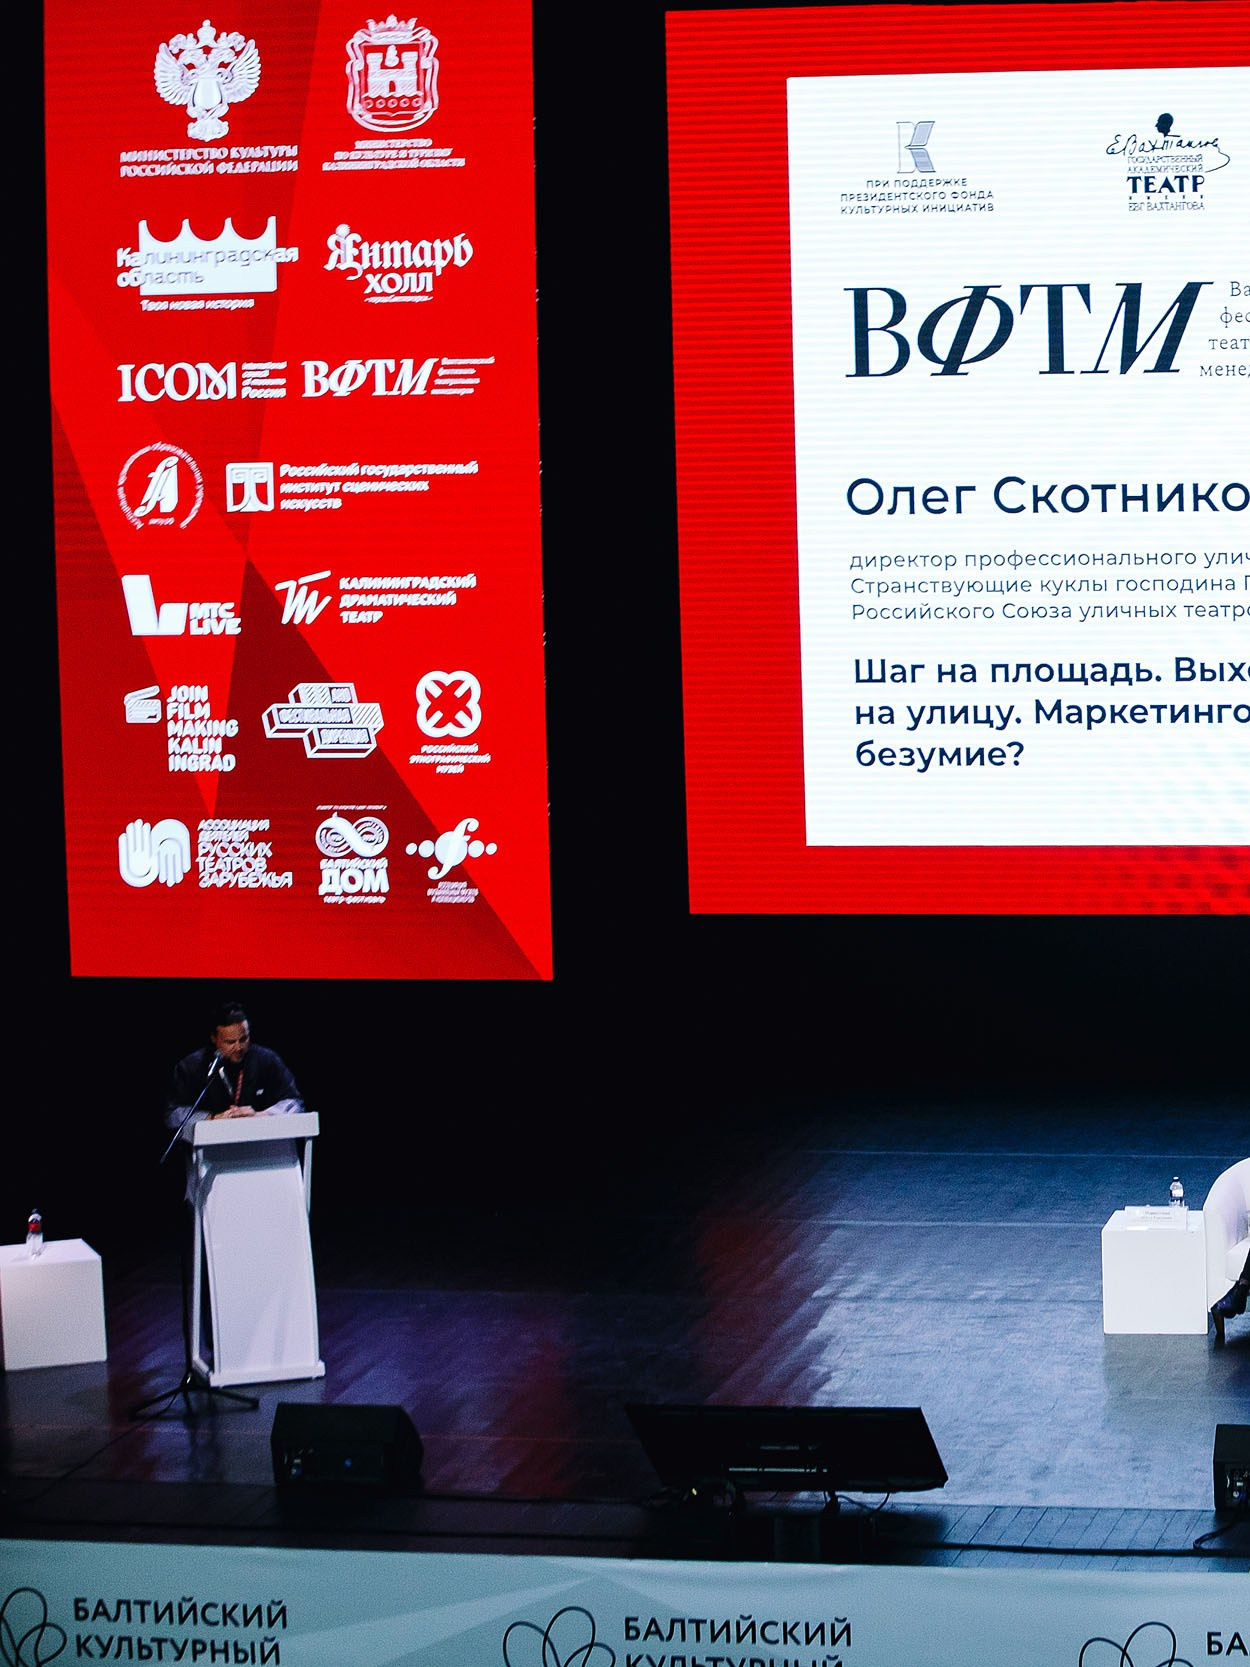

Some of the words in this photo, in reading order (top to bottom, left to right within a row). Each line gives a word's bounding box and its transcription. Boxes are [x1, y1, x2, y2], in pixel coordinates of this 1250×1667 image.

[120, 147, 228, 163] МИНИСТЕРСТВО
[230, 145, 298, 159] КУЛЬТУРЫ
[120, 160, 214, 177] РОССИЙСКОЙ
[216, 160, 298, 174] ФЕДЕРАЦИИ
[866, 179, 890, 189] ПРИ
[894, 177, 968, 189] ПОДДЕРЖКЕ
[1126, 175, 1205, 194] ТЕАТР
[841, 192, 946, 202] ПРЕЗИДЕНТСКОГО
[950, 190, 994, 200] ФОНДА
[841, 204, 918, 215] КУЛЬТУРНЫХ
[922, 203, 994, 213] ИНИЦИАТИВ
[117, 247, 299, 268] Калининградская
[323, 224, 474, 280] Янтарь
[117, 268, 205, 288] область
[843, 281, 1215, 378] ВФТМ
[117, 361, 237, 402] ICOM
[300, 357, 440, 398] ВФТМ
[280, 462, 359, 477] Российский
[360, 460, 479, 478] государственный
[280, 482, 342, 496] институт
[342, 481, 430, 494] сценических
[846, 477, 977, 517] Олег
[280, 497, 343, 512] искусств
[849, 553, 957, 572] директор
[965, 549, 1197, 571] профессионального
[339, 573, 477, 590] КАЛИНИНГРАДСКИЙ
[850, 577, 1032, 598] Странствующие
[1040, 579, 1108, 597] куклы
[1116, 578, 1236, 596] господина
[339, 591, 457, 608] ДРАМАТИЧЕСКИЙ
[340, 610, 383, 623] ТЕАТР
[852, 602, 995, 620] Российского
[1002, 602, 1072, 619] Союза
[1079, 605, 1177, 623] уличных
[189, 617, 242, 636] LIVE
[854, 658, 926, 684] Шаг
[937, 663, 977, 683] на
[991, 662, 1162, 688] площадь.
[166, 685, 208, 703] JOIN
[166, 702, 211, 720] FILM
[855, 705, 895, 725] на
[906, 704, 1022, 732] улицу.
[167, 719, 239, 737] MAKING
[167, 737, 223, 755] KALIN
[168, 754, 237, 772] INGRAD
[855, 739, 1025, 775] безумие?
[198, 842, 274, 858] РУССКИХ
[195, 857, 268, 873] ТЕАТРОВ
[198, 872, 293, 888] ЗАРУБЕЖЬЯ
[318, 868, 390, 896] ДОМ
[73, 1596, 288, 1630] БАЛТИЙСКИЙ
[624, 1614, 852, 1647] БАЛТИЙСКИЙ
[75, 1633, 282, 1666] КУЛЬТУРНЫЙ
